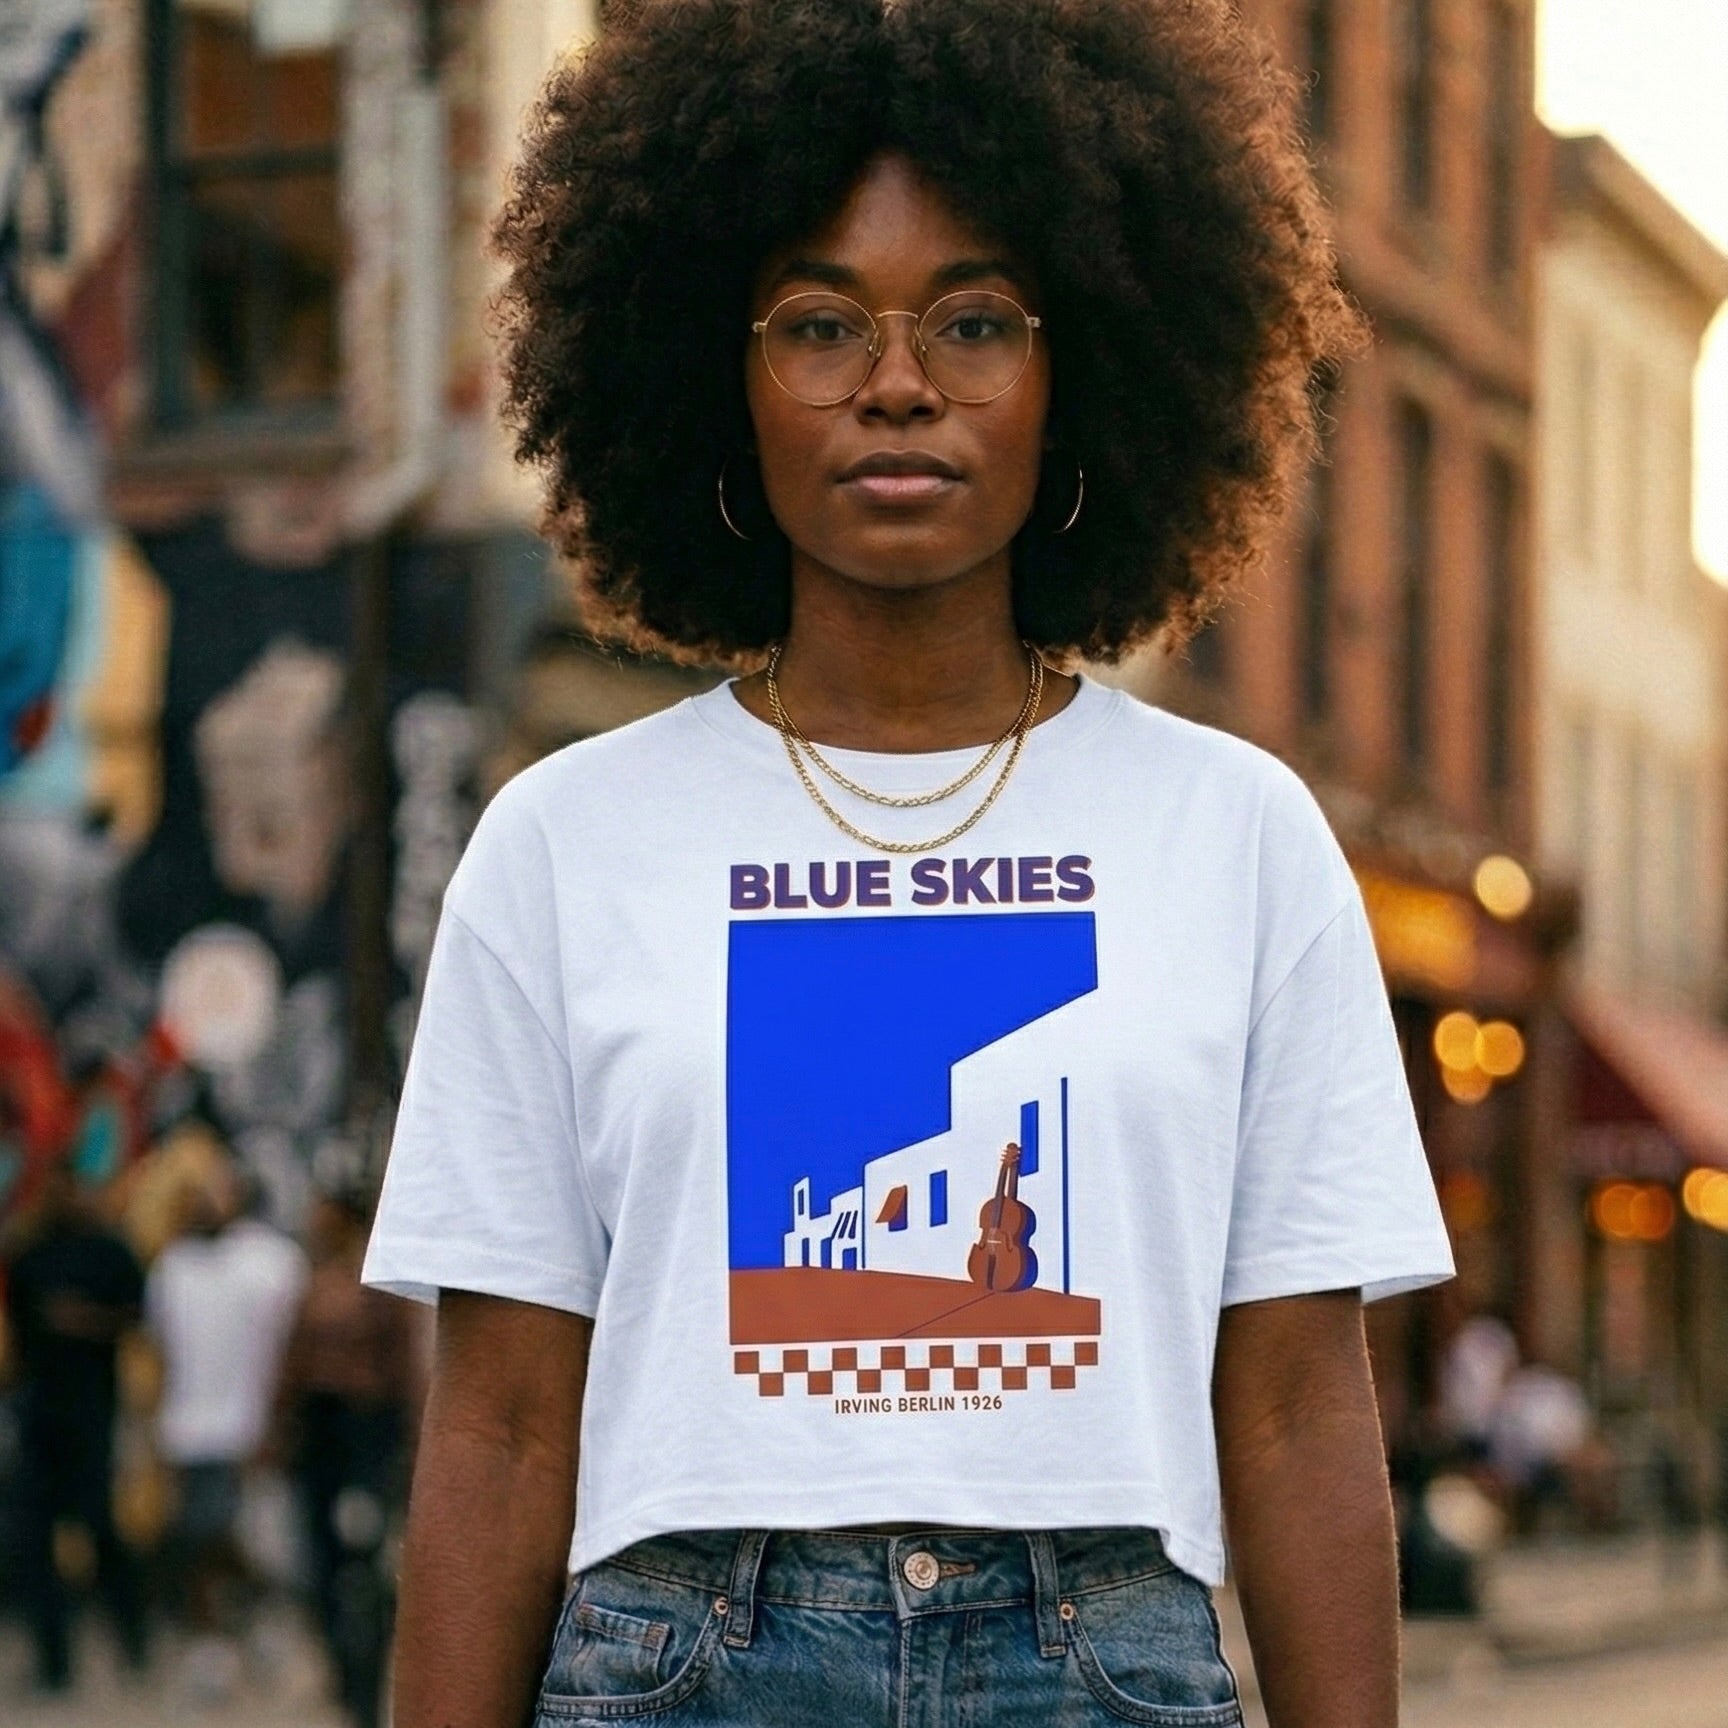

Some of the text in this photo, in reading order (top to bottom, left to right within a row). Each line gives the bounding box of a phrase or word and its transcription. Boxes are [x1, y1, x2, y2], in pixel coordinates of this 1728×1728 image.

[730, 855, 1096, 910] BLUE SKIES
[835, 1395, 1002, 1413] IRVING BERLIN 1926
